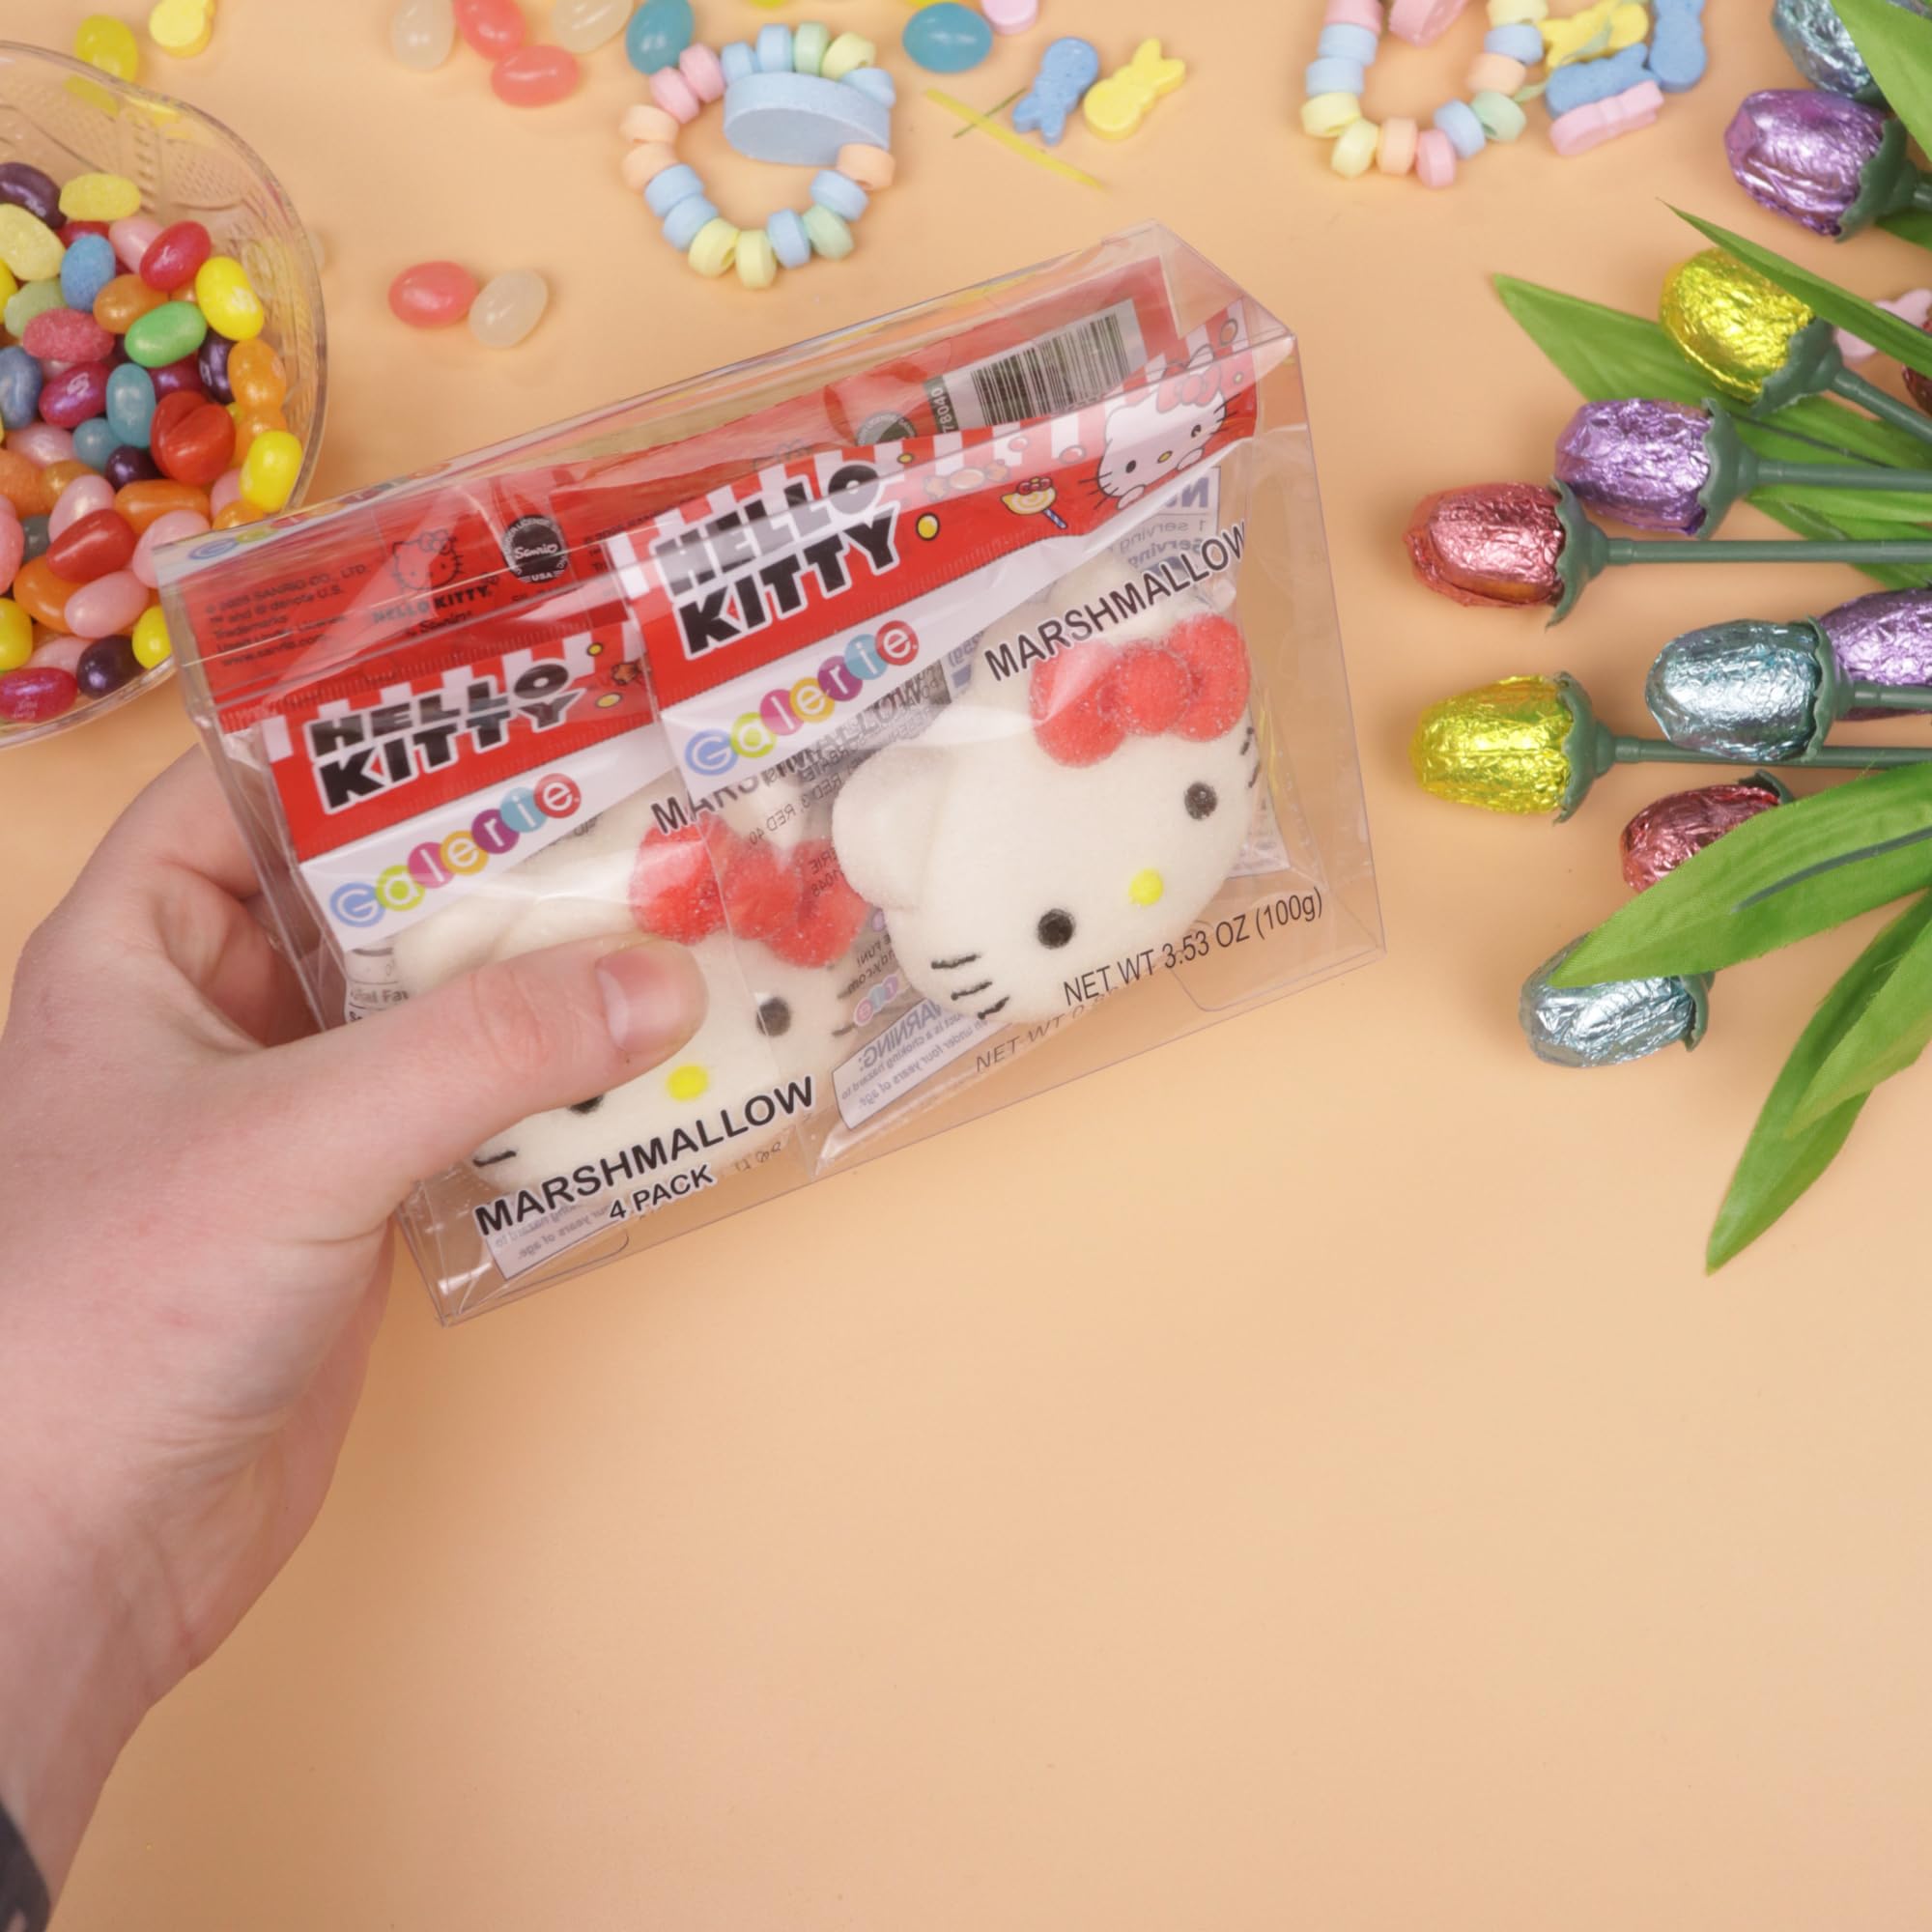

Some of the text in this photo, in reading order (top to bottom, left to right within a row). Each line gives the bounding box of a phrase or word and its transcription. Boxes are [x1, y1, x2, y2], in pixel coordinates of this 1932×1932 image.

[513, 543, 558, 560] Sanrio
[530, 571, 554, 582] USA
[653, 463, 881, 597] HELLO
[678, 507, 895, 655] KITTY
[434, 583, 493, 611] KITTY
[983, 521, 1246, 682] MARSHMALLOW
[306, 662, 571, 757] HELLO
[319, 691, 580, 810] KITTY
[684, 619, 920, 777] Galerie
[329, 773, 582, 928] Galerie
[1064, 886, 1324, 1007] NET WT 3.53 OZ (100g)
[976, 1013, 1066, 1072] NET WT
[475, 1075, 813, 1236] MARSHMALLOW
[610, 1164, 714, 1220] 4 PACK
